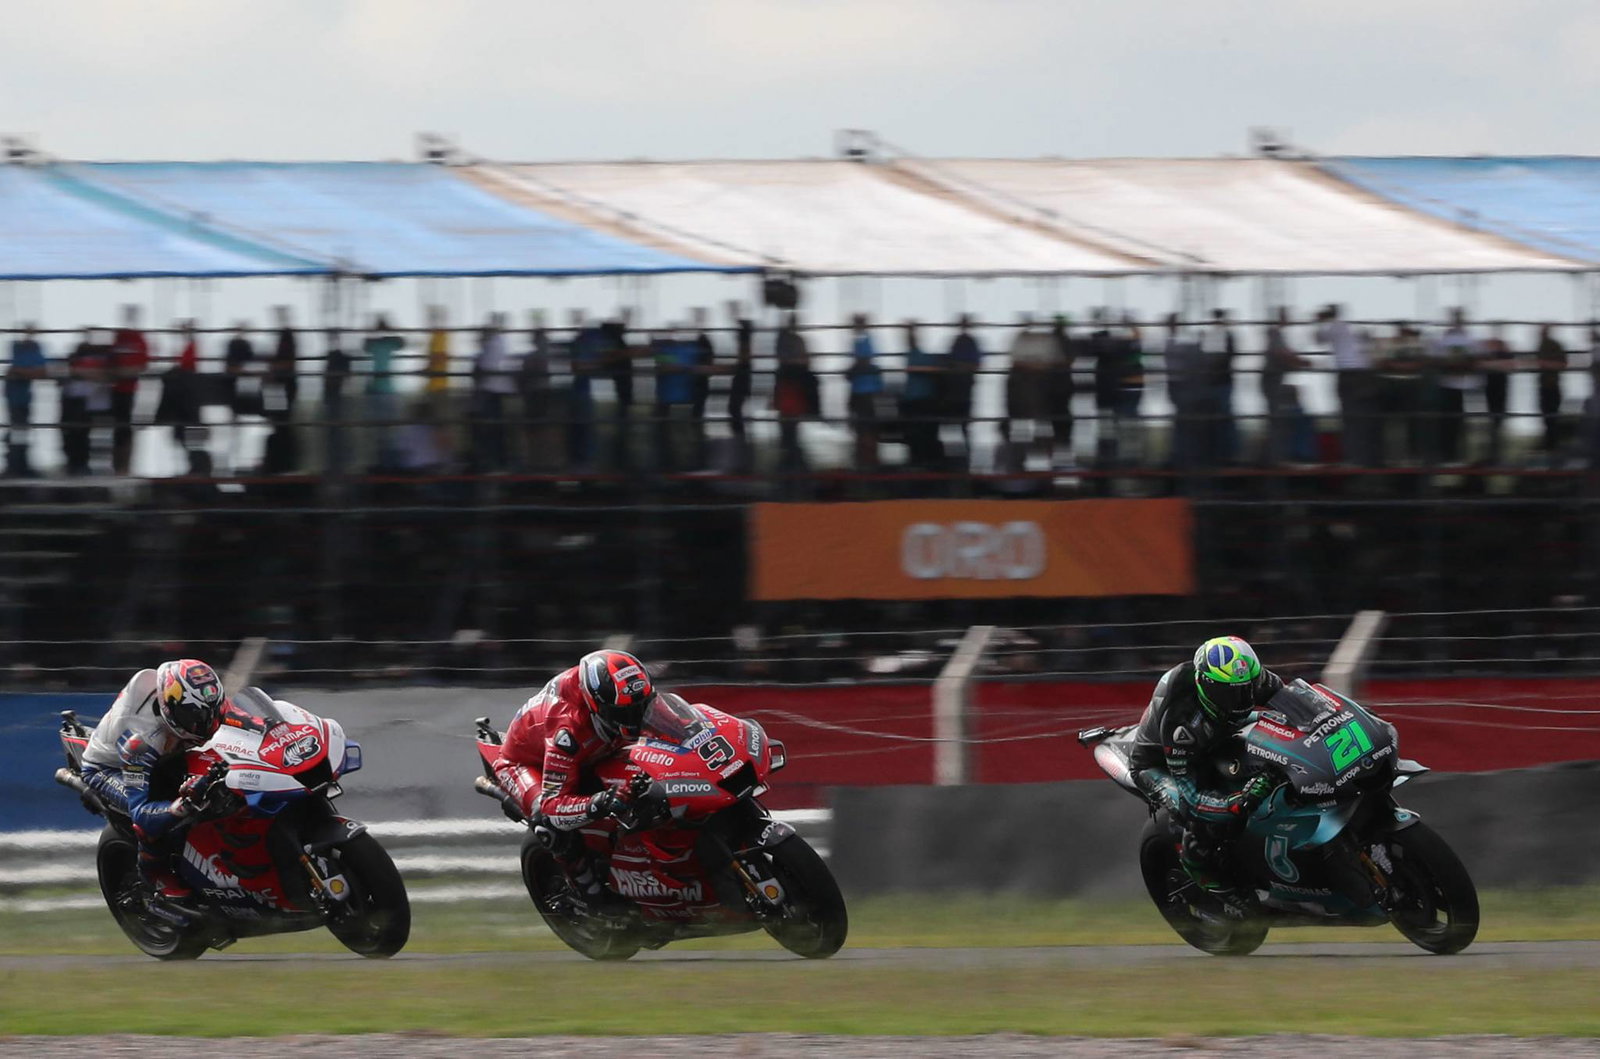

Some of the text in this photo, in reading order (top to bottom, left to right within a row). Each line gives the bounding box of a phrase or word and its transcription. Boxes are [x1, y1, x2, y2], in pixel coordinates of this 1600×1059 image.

[901, 520, 1046, 580] ORO
[1258, 720, 1295, 739] BARRACUDA
[1303, 711, 1354, 748] PETRONAS
[215, 743, 255, 757] PRAMAC
[259, 726, 313, 757] PRAMAC
[1323, 721, 1374, 772] 21
[698, 734, 735, 771] 9
[1247, 744, 1288, 765] PETRONAS
[1335, 766, 1360, 786] europe
[665, 783, 711, 793] Lenovo
[1300, 785, 1335, 796] Malaysia
[556, 803, 586, 813] DUCATI
[610, 866, 659, 886] MISS
[618, 880, 703, 901] WINNOW
